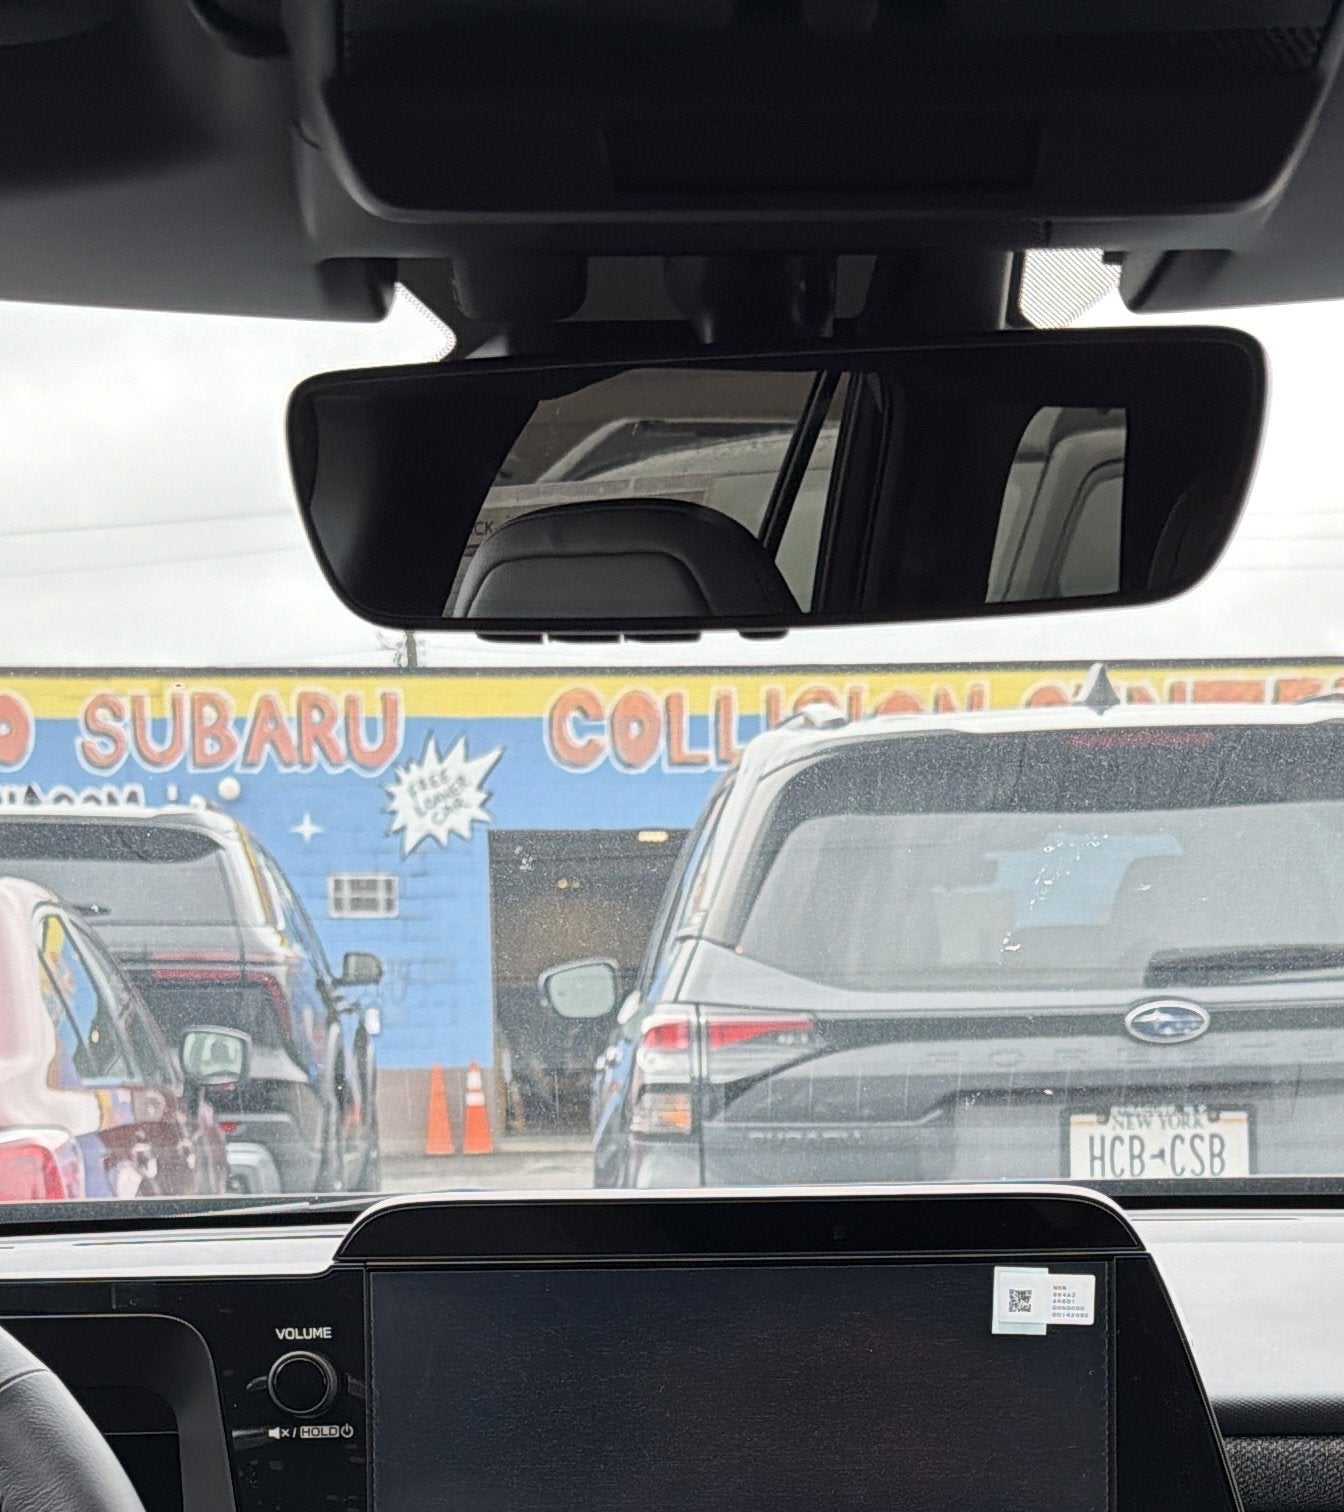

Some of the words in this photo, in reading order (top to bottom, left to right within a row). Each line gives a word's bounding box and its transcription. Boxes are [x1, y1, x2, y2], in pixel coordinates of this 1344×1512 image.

[78, 690, 404, 772] SUBARU
[1111, 1115, 1153, 1131] NEW
[1159, 1113, 1206, 1131] YORK
[275, 1327, 333, 1340] VOLUME
[301, 1427, 338, 1437] HOLD
